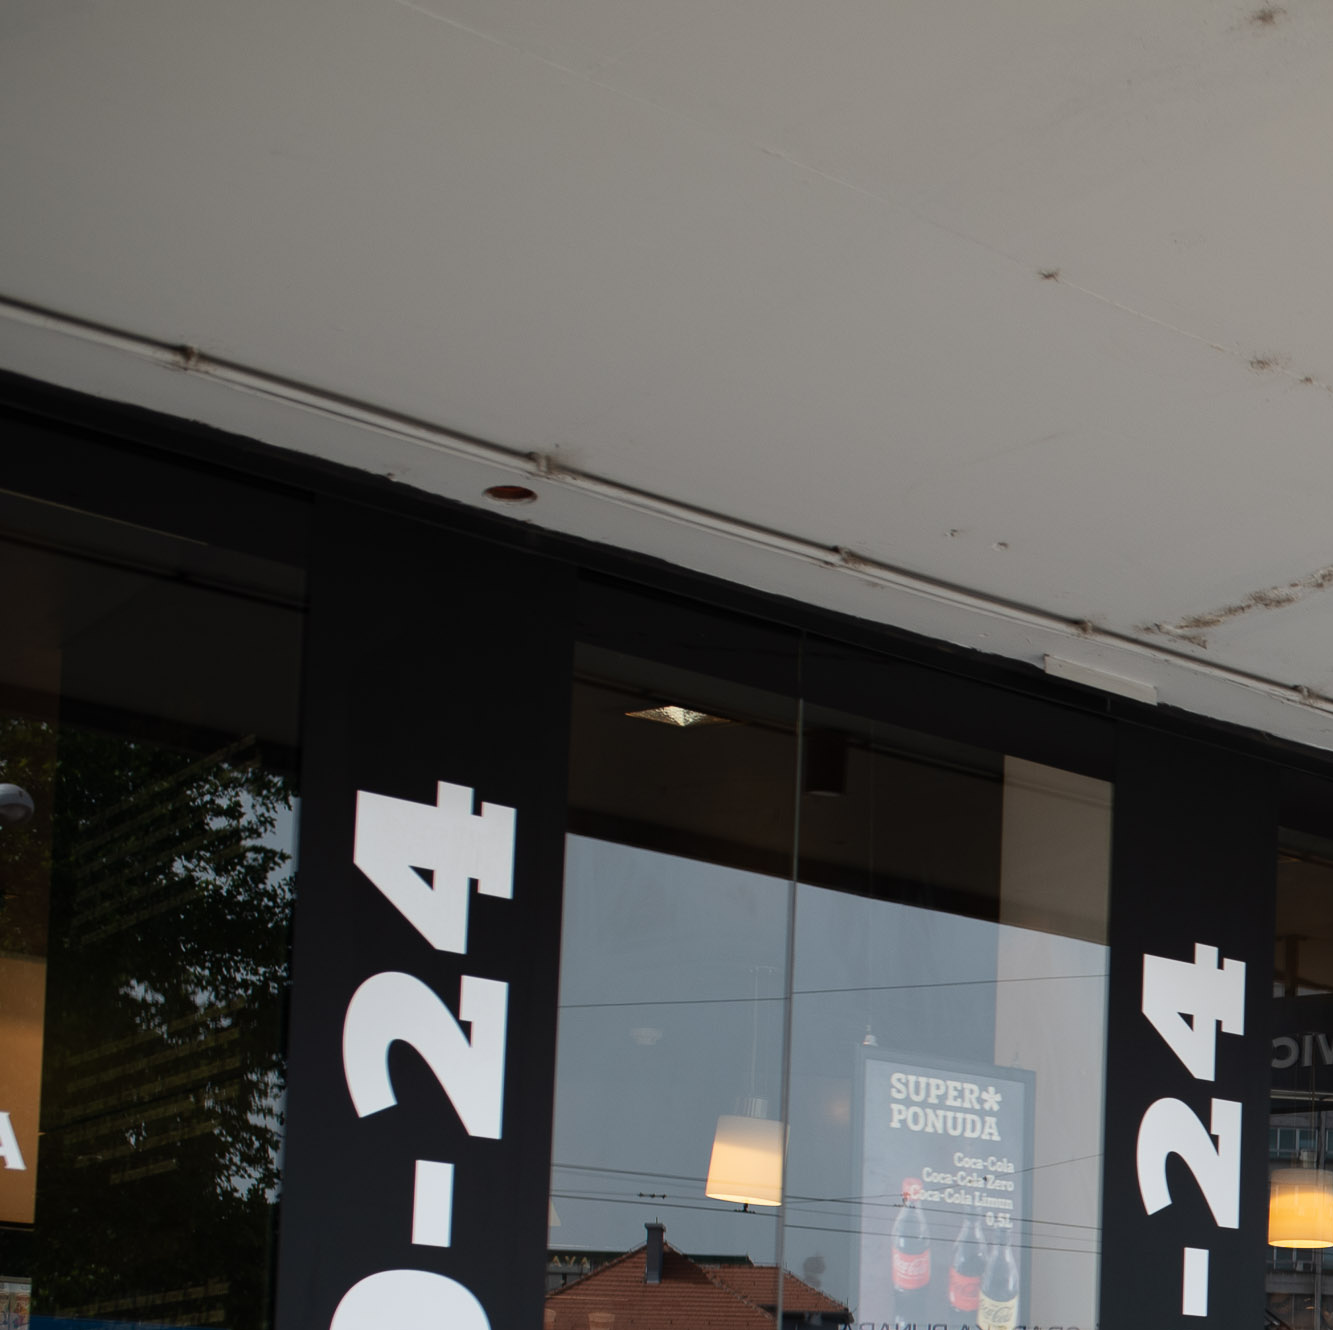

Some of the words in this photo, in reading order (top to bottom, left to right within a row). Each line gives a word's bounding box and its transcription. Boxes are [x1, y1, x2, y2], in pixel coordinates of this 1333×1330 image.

[890, 1072, 981, 1110] SUPER
[889, 1103, 1001, 1142] PONUDA
[953, 1152, 1015, 1173] Coca-Cola
[922, 1167, 984, 1188] Coca-Cola
[986, 1174, 1015, 1191] Zero
[910, 1184, 973, 1206] Coca-Cola
